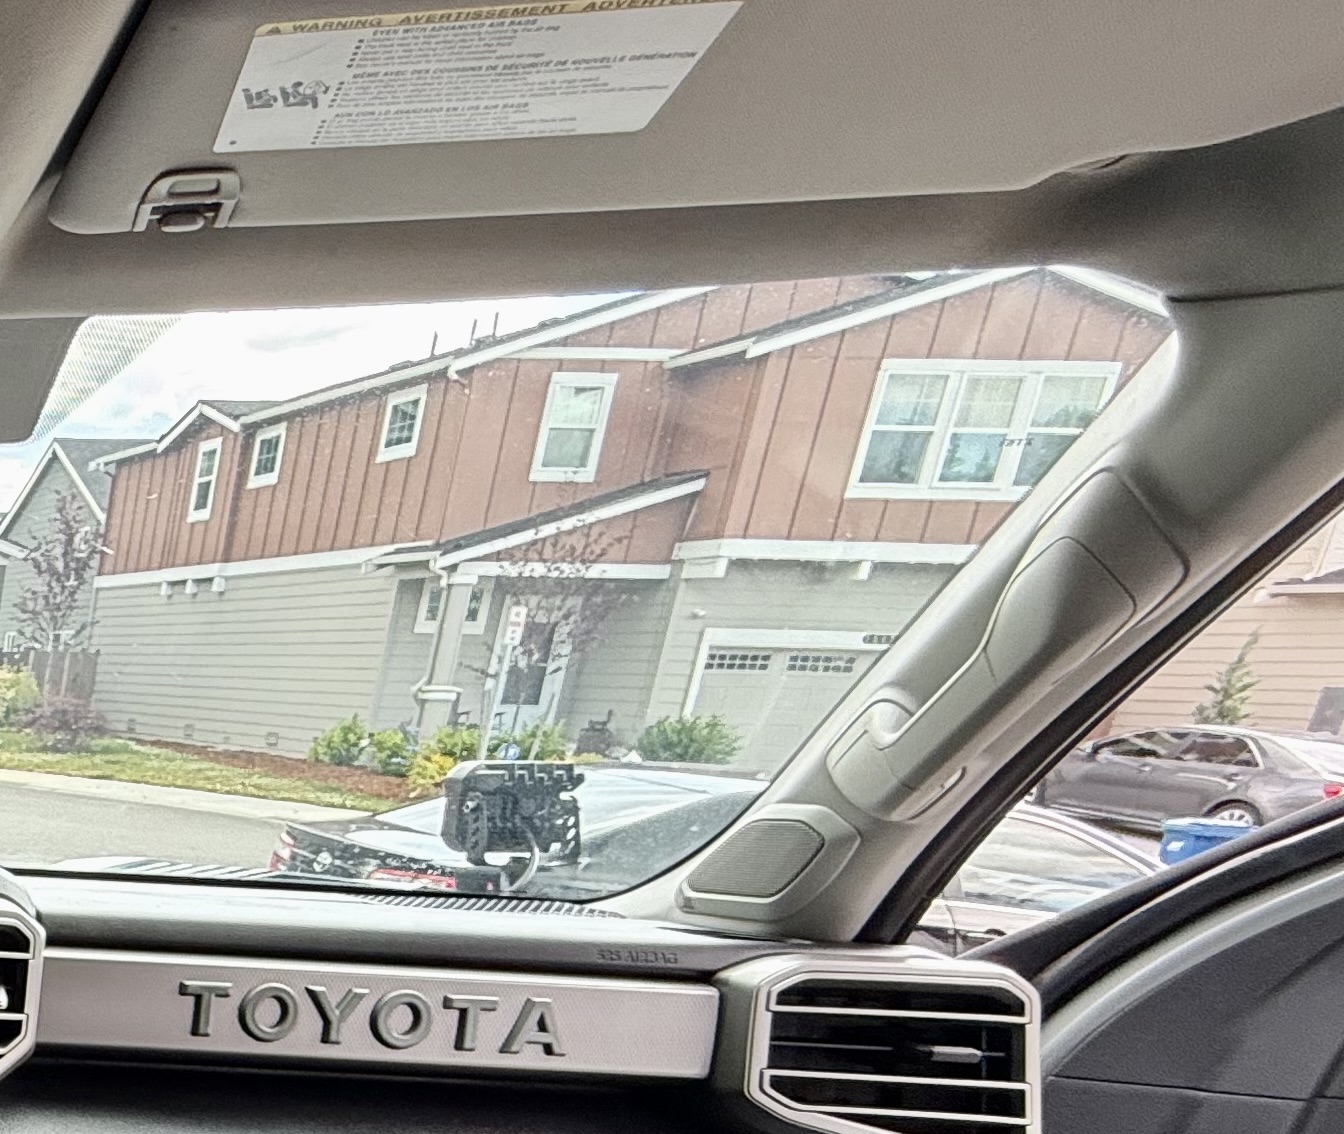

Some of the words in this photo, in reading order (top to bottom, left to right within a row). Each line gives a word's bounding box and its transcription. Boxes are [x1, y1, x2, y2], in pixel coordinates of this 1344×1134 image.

[292, 17, 383, 33] WARNING
[399, 5, 568, 26] AVERTISSEMENT
[178, 980, 566, 1057] TOYOTA
